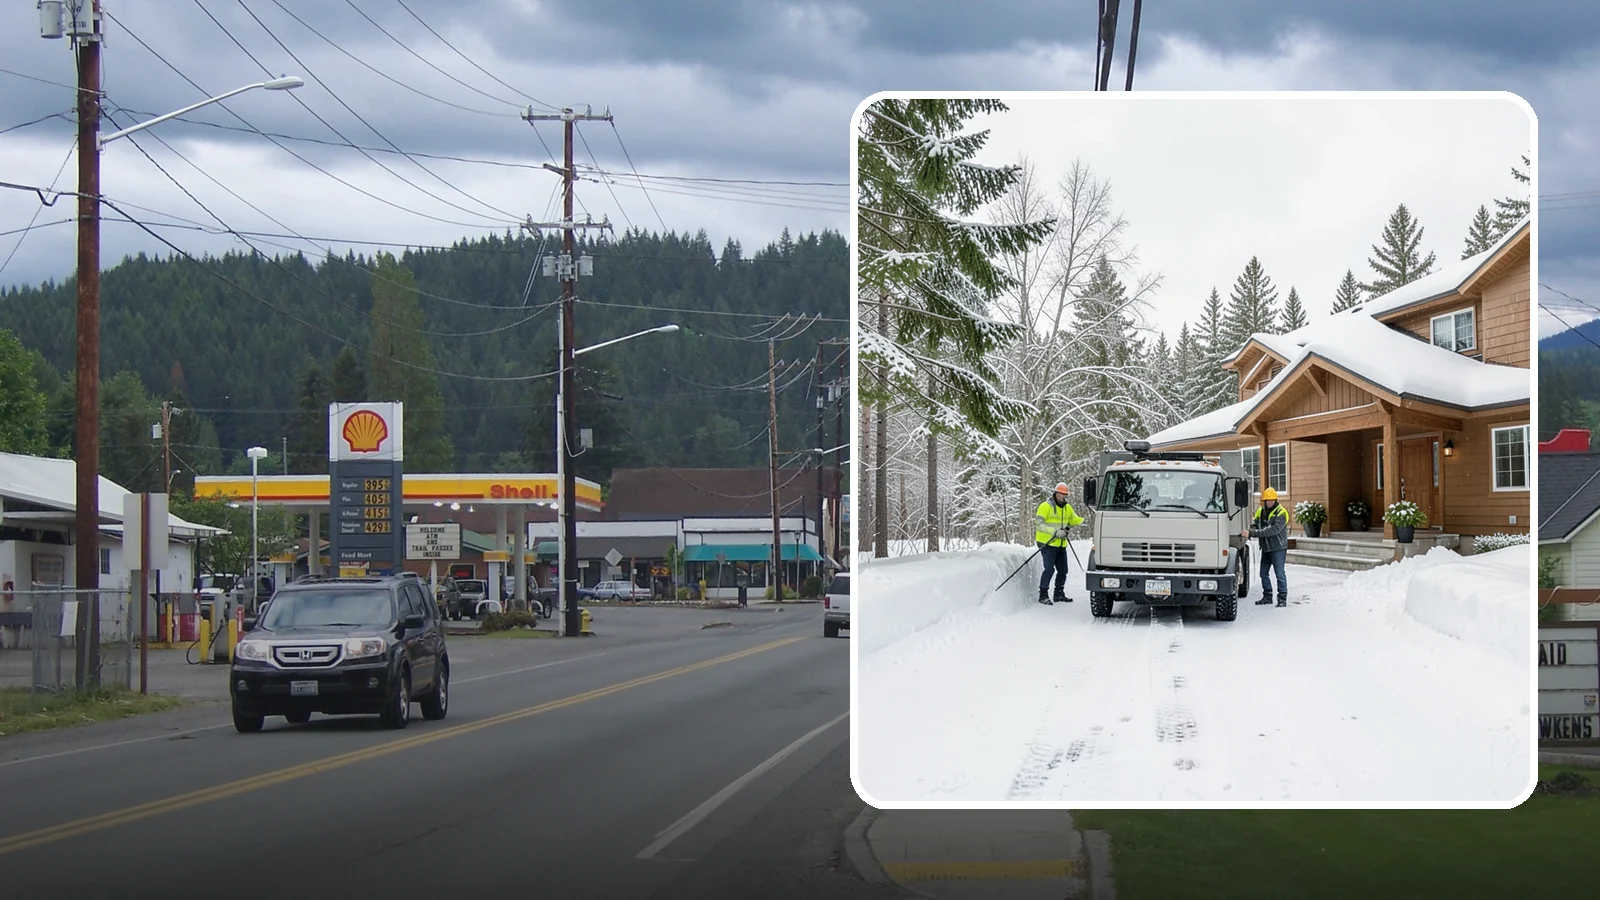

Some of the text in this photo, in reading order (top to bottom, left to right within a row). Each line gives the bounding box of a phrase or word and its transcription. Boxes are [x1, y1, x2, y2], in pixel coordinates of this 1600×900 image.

[365, 480, 383, 490] 395
[490, 484, 547, 499] Shell
[365, 494, 383, 504] 405
[365, 508, 383, 518] 415
[365, 522, 383, 532] 429
